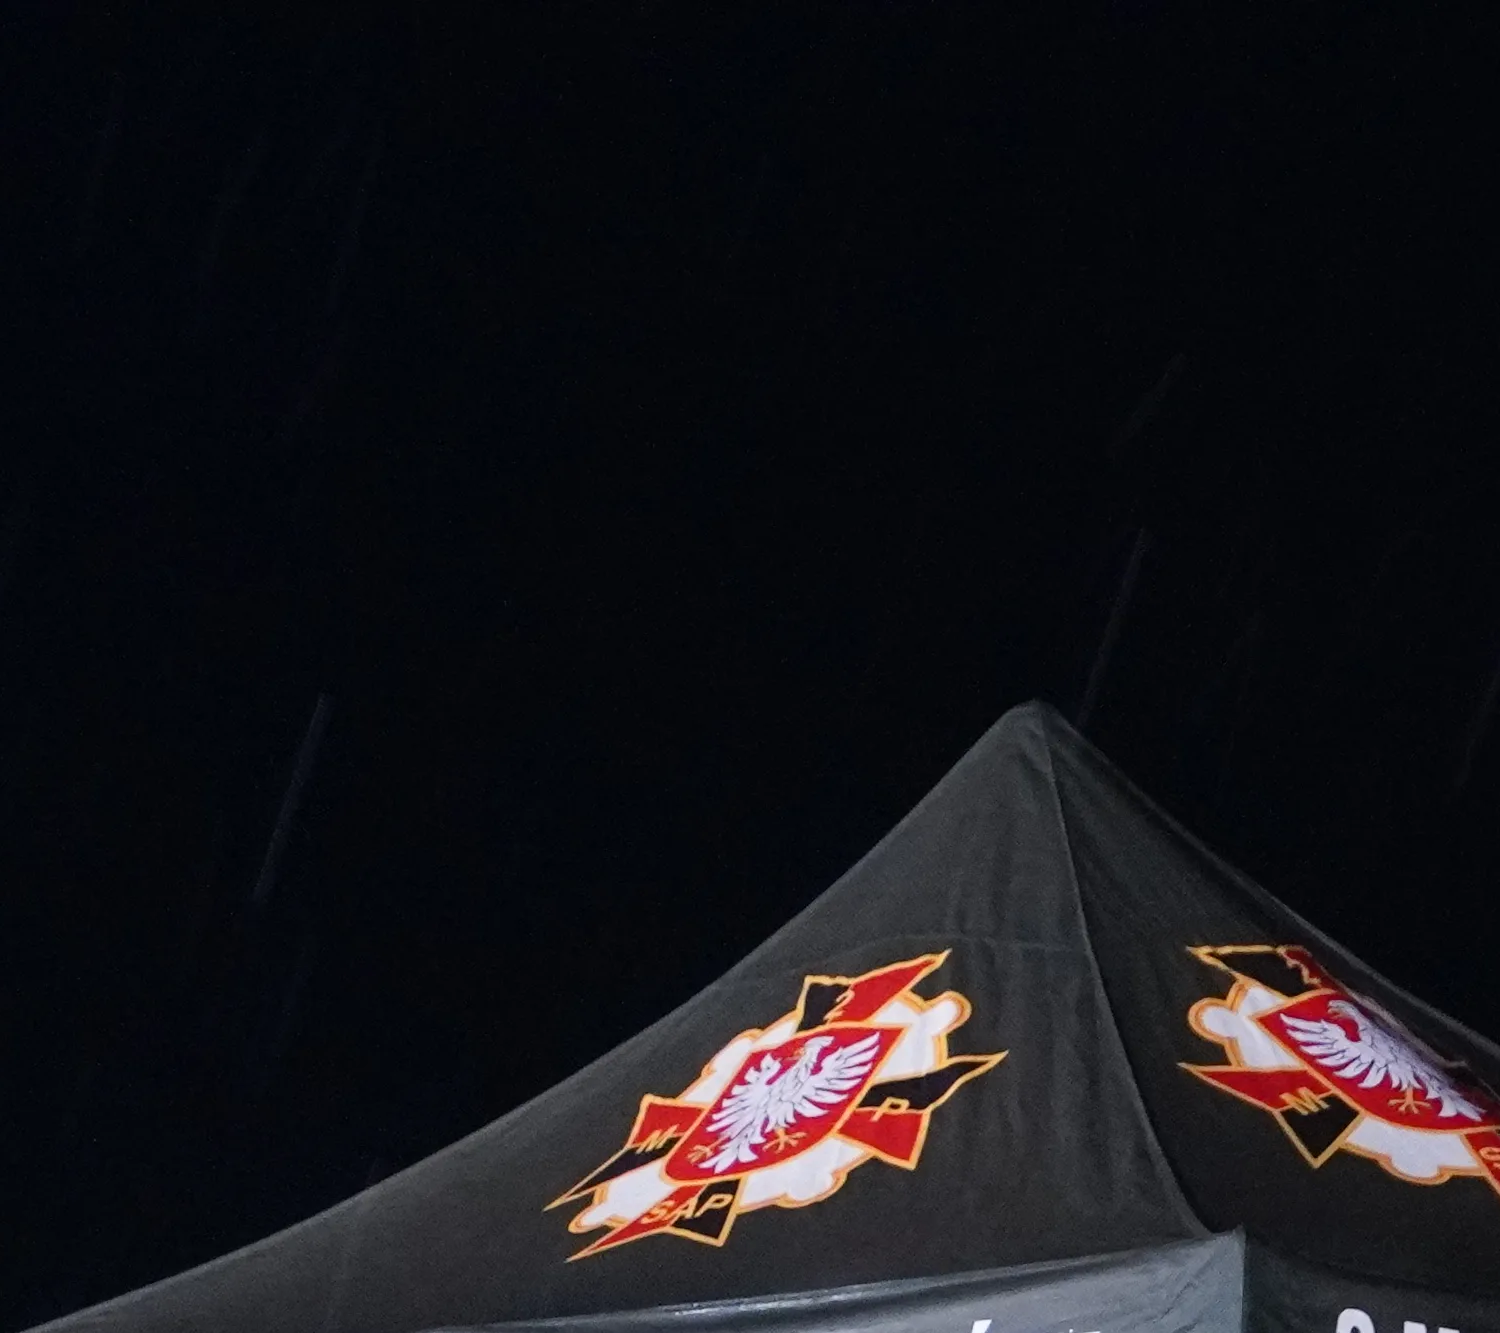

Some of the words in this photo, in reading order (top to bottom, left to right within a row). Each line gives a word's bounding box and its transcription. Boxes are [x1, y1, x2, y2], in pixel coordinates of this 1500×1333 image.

[824, 989, 855, 1021] 2
[871, 1097, 910, 1123] P
[1279, 1086, 1330, 1116] M
[639, 1193, 734, 1225] SAP
